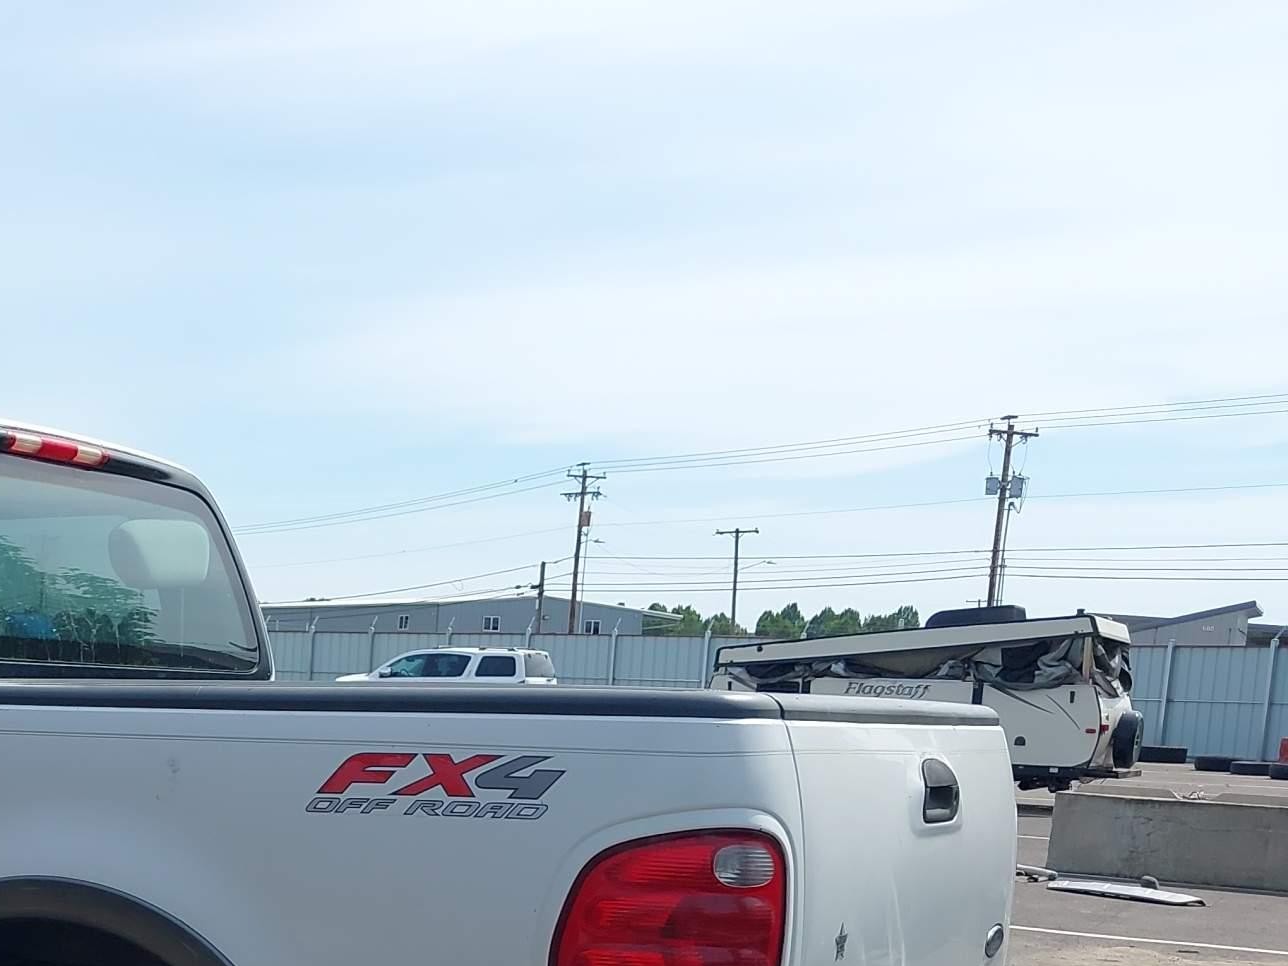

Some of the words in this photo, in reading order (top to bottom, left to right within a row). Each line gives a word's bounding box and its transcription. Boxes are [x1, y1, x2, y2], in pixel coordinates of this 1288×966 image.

[844, 682, 932, 698] Flagstaff
[316, 752, 567, 800] FX4
[305, 797, 397, 814] OFF
[403, 799, 549, 820] ROAD
